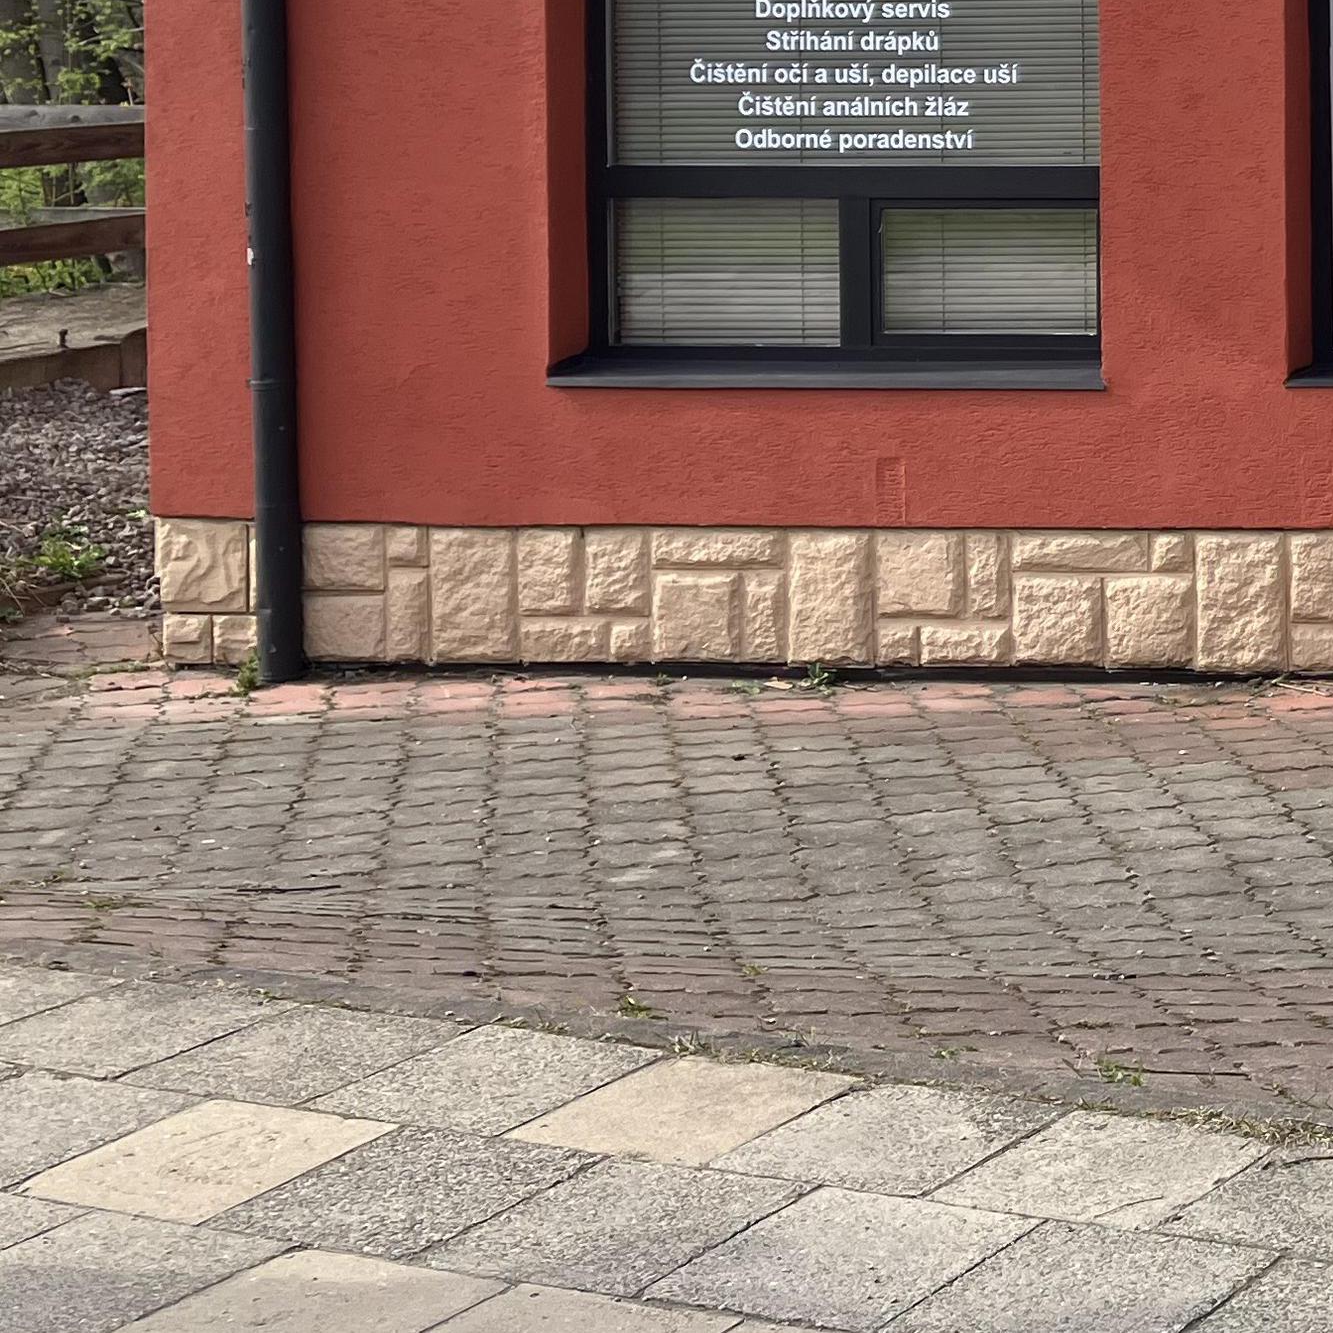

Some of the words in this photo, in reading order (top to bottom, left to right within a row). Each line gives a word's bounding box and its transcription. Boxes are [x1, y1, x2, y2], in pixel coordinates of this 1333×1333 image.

[881, 0, 951, 19] servis
[766, 30, 854, 52] Stříhání
[861, 30, 939, 56] drápků
[690, 57, 768, 84] Čištění
[774, 63, 808, 84] očí
[815, 67, 827, 84] a
[834, 62, 874, 87] uší,
[881, 62, 977, 88] depilace
[983, 62, 1018, 84] uší
[738, 90, 816, 117] Čištění
[823, 95, 918, 117] análních
[924, 95, 969, 117] žláz
[735, 128, 832, 149] Odborné
[839, 127, 973, 154] poradenství
